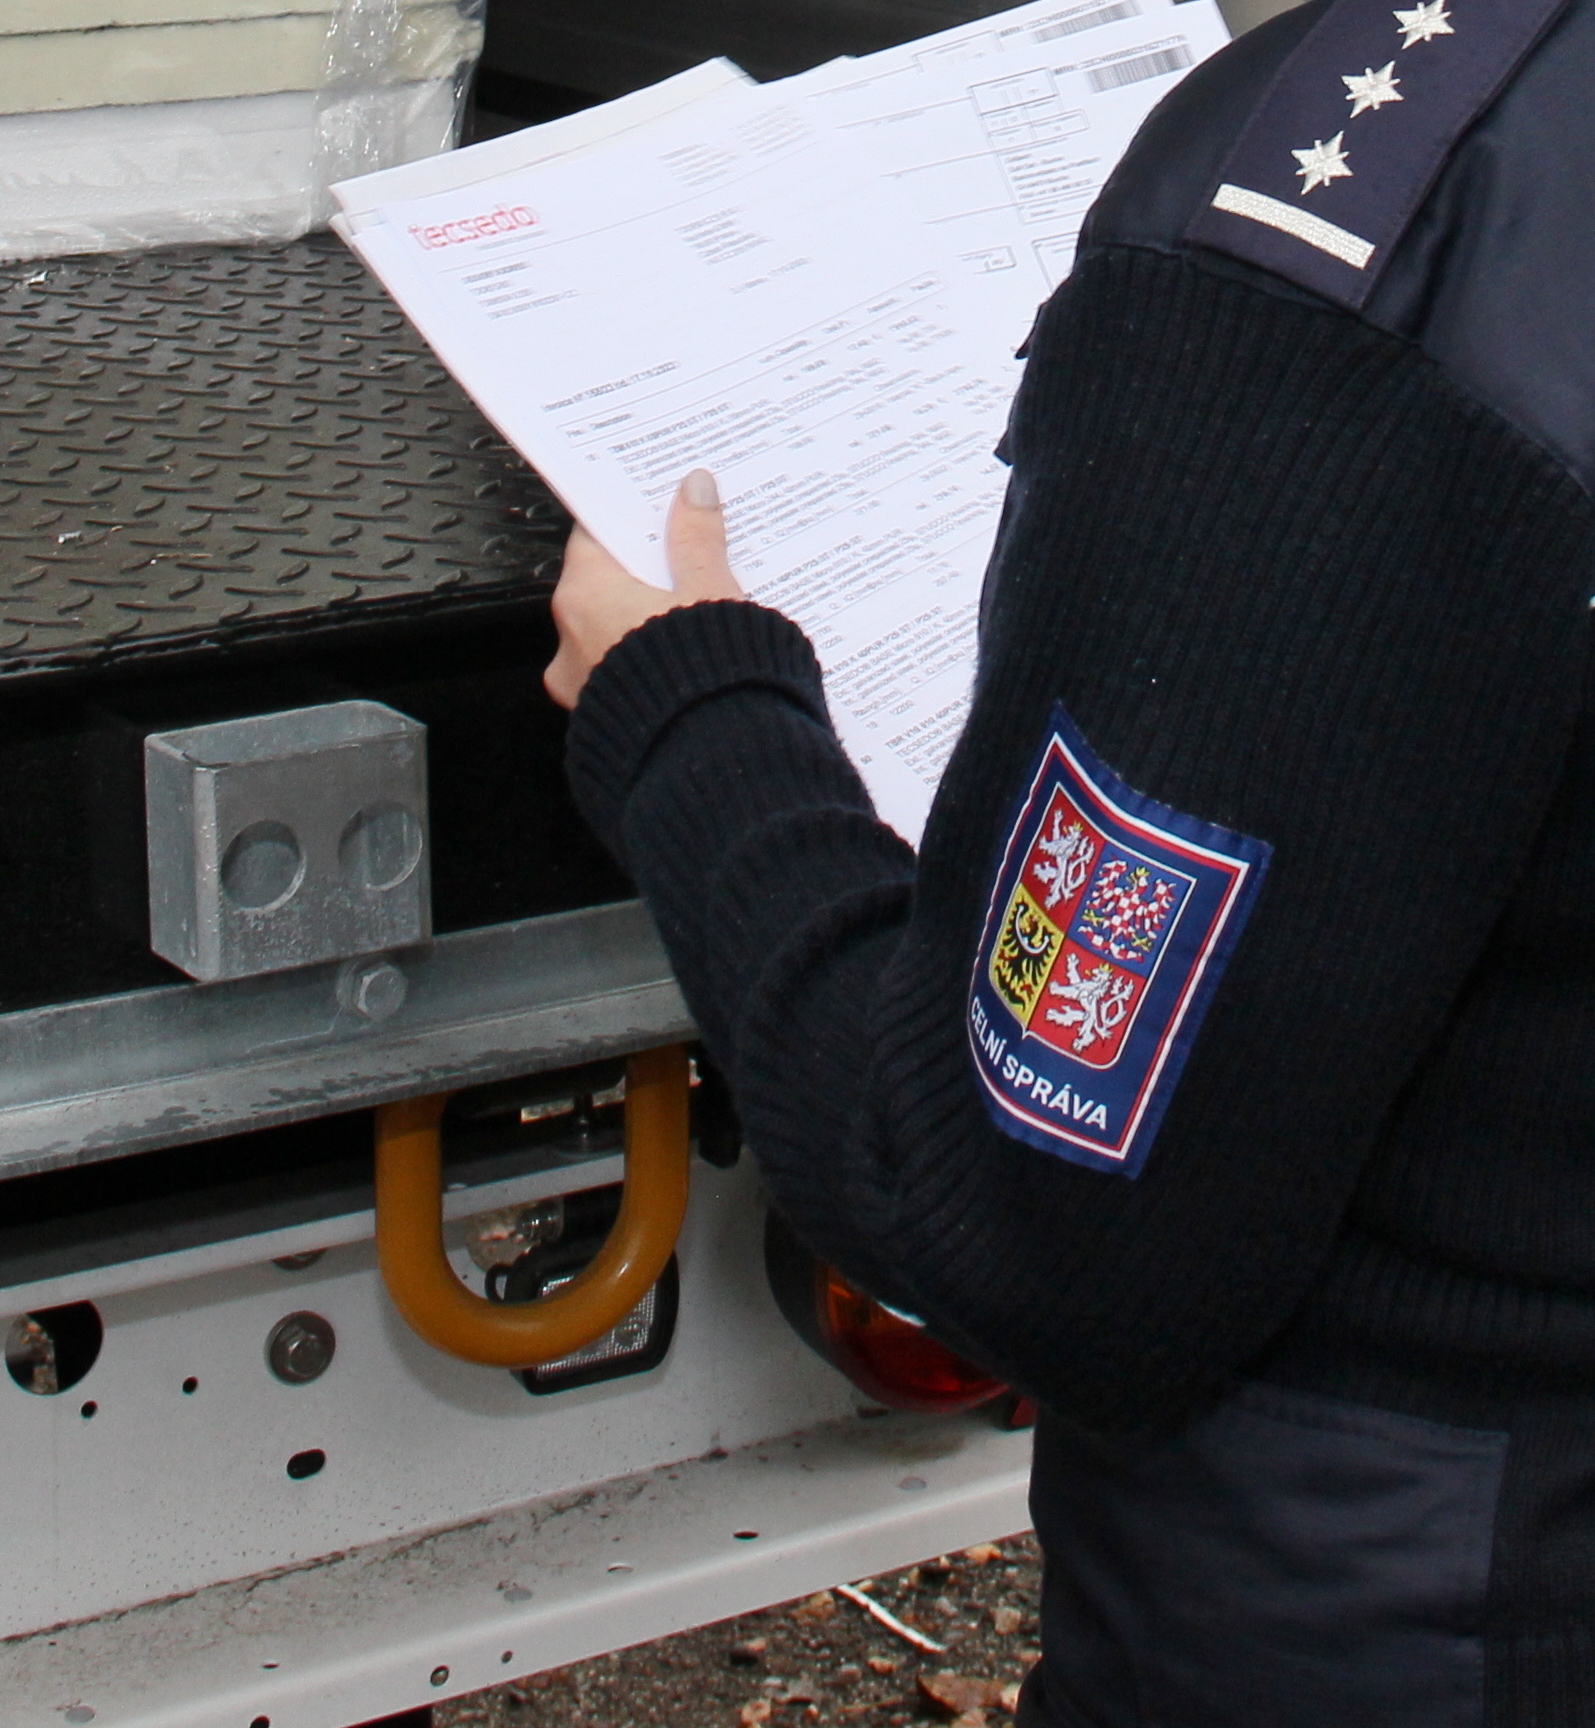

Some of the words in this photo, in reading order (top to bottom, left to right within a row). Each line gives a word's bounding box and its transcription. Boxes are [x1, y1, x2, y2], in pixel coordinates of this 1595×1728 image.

[407, 202, 538, 251] tecsedo
[970, 995, 1005, 1066] CELNÍ
[1002, 1052, 1109, 1131] SPRÁVA
